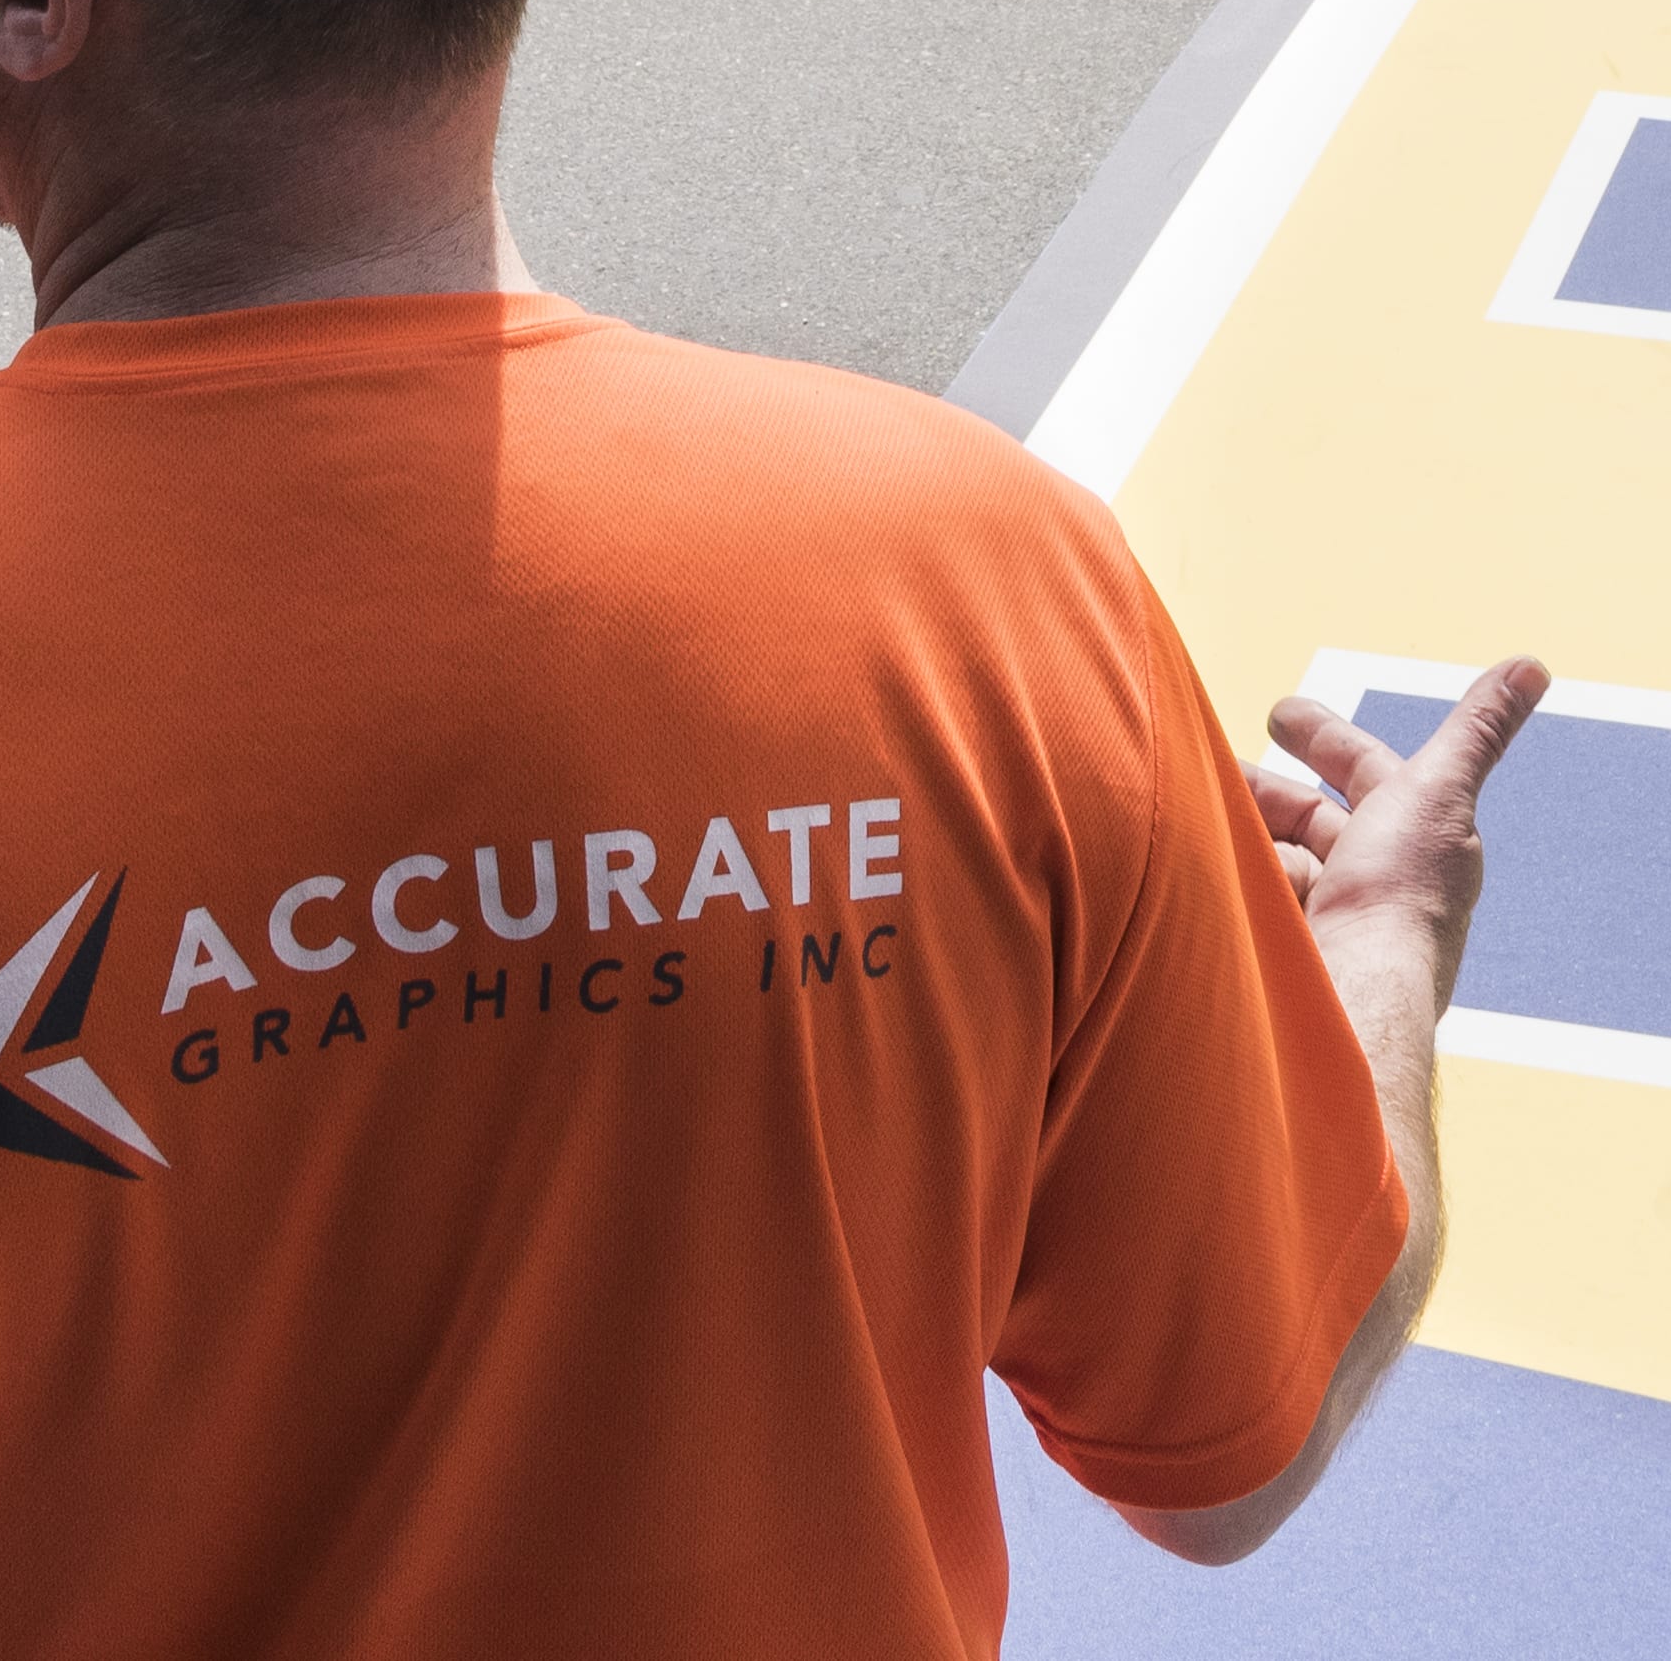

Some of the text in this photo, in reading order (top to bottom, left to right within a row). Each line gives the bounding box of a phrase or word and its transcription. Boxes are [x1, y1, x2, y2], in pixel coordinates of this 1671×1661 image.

[161, 796, 906, 1017] ACCURATE
[168, 924, 900, 1086] GRAPHICS INC
